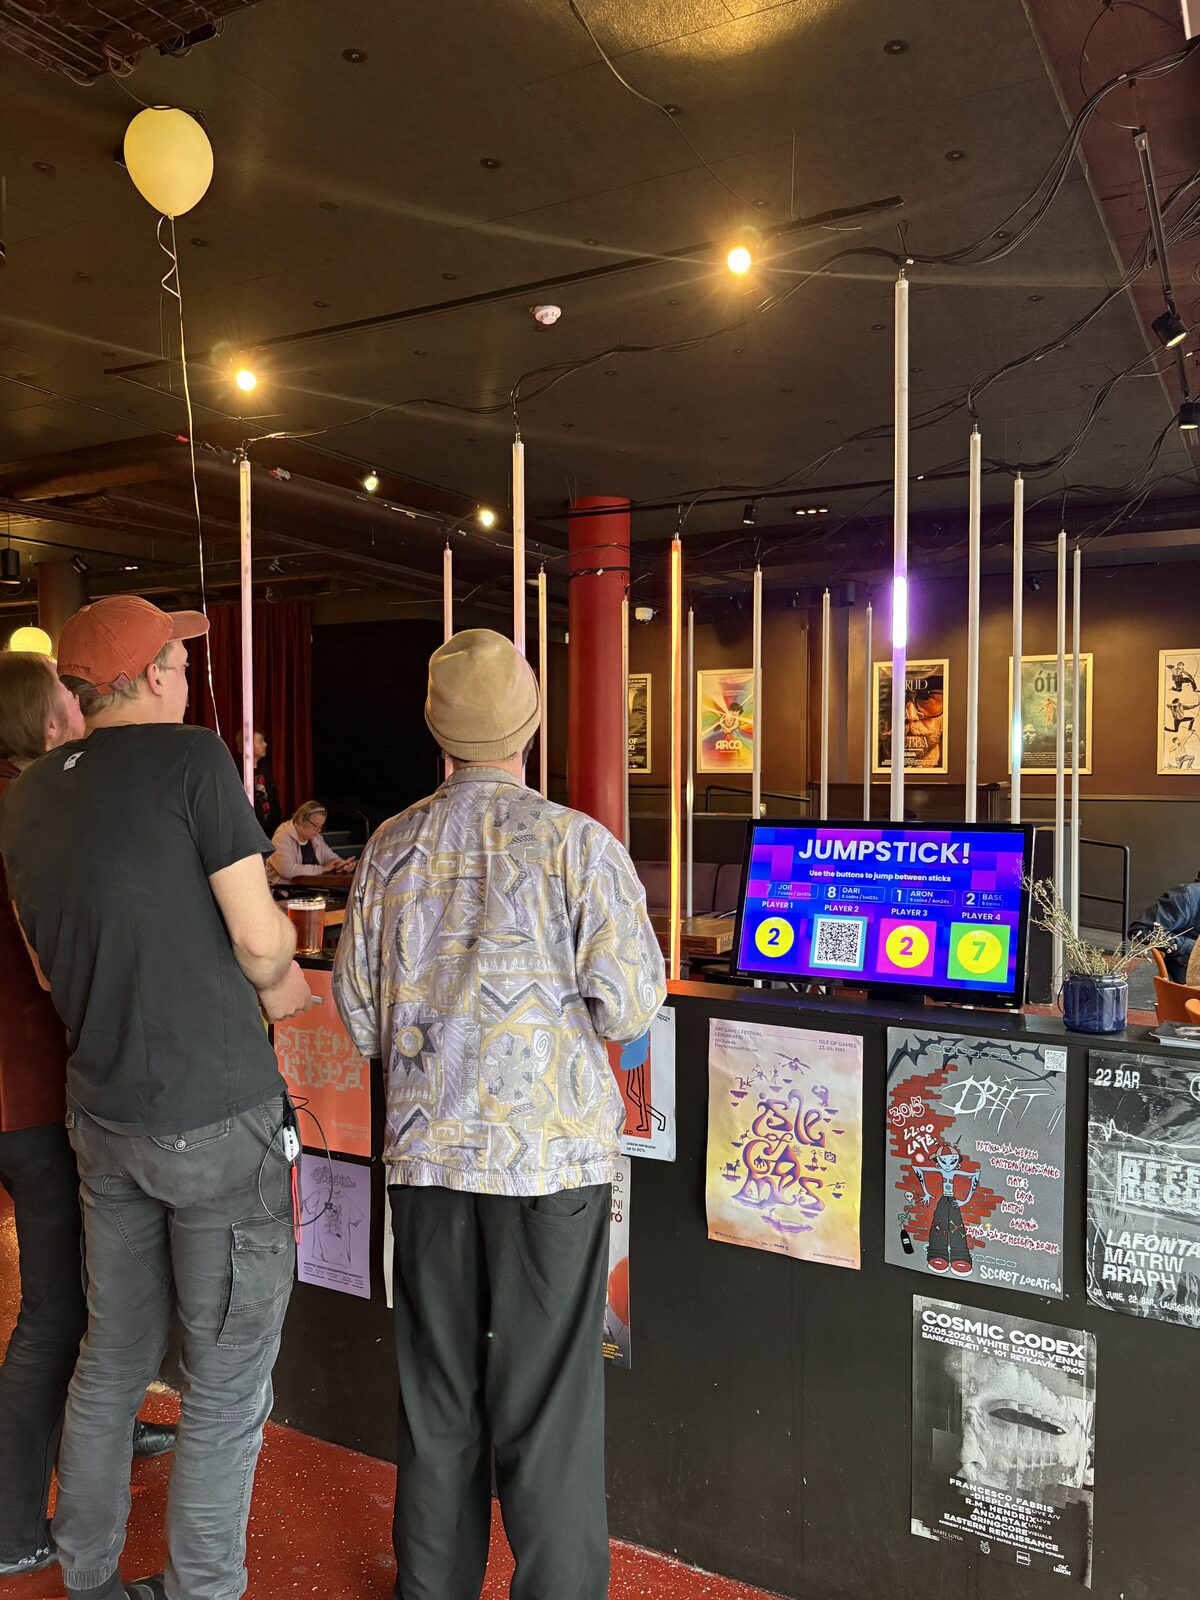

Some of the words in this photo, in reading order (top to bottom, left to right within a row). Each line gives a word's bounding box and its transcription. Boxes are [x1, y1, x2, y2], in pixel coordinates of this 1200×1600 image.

[715, 740, 743, 750] ARCO
[798, 839, 970, 865] JUMPSTICK!
[809, 869, 822, 877] Use
[823, 869, 835, 877] the
[836, 871, 864, 879] buttons
[873, 872, 893, 882] jump
[894, 873, 927, 881] between
[928, 874, 952, 882] sticks
[827, 886, 836, 898] 8
[896, 889, 902, 902] 1
[910, 890, 934, 898] ARON
[965, 893, 976, 905] 2
[762, 901, 788, 909] PLAYER
[824, 904, 852, 912] PLAYER
[853, 905, 860, 913] 2
[891, 908, 921, 916] PLAYER
[922, 909, 928, 917] 3
[961, 911, 994, 920] PLAYER
[994, 913, 1001, 921] 4
[768, 927, 780, 946] 2
[899, 936, 913, 956] 2
[972, 941, 986, 961] 7
[838, 1041, 857, 1049] GAMES
[1093, 1068, 1112, 1087] 22
[1113, 1069, 1141, 1089] BAR
[903, 1123, 935, 1141] 22:00
[1104, 1247, 1185, 1273] MATRW
[980, 1265, 1020, 1286] SECRET
[1019, 1275, 1062, 1294] LOCATION
[921, 1310, 1005, 1340] COSMIC
[1009, 1329, 1087, 1360] CODEX
[921, 1331, 980, 1352] BANKASTRÆTI
[993, 1349, 1007, 1358] 101
[1062, 1365, 1086, 1376] 19:00
[976, 1336, 1010, 1351] WHITE
[1012, 1344, 1045, 1359] LOTUS
[1046, 1353, 1086, 1368] VENUE
[949, 1478, 1013, 1502] FRANCESCO
[1016, 1498, 1055, 1513] FABRIS
[965, 1497, 987, 1510] R.M.
[989, 1505, 1037, 1523] HENDRIX
[972, 1508, 1029, 1529] ANDARTAK
[943, 1512, 987, 1532] EASTERN
[988, 1526, 1059, 1552] RENAISSANCE
[970, 1514, 1029, 1536] GRINGCORE
[1027, 1530, 1053, 1541] VISUALS
[996, 1537, 1012, 1545] OUTER
[1012, 1541, 1028, 1550] SPACE
[1028, 1546, 1044, 1554] MUSIC
